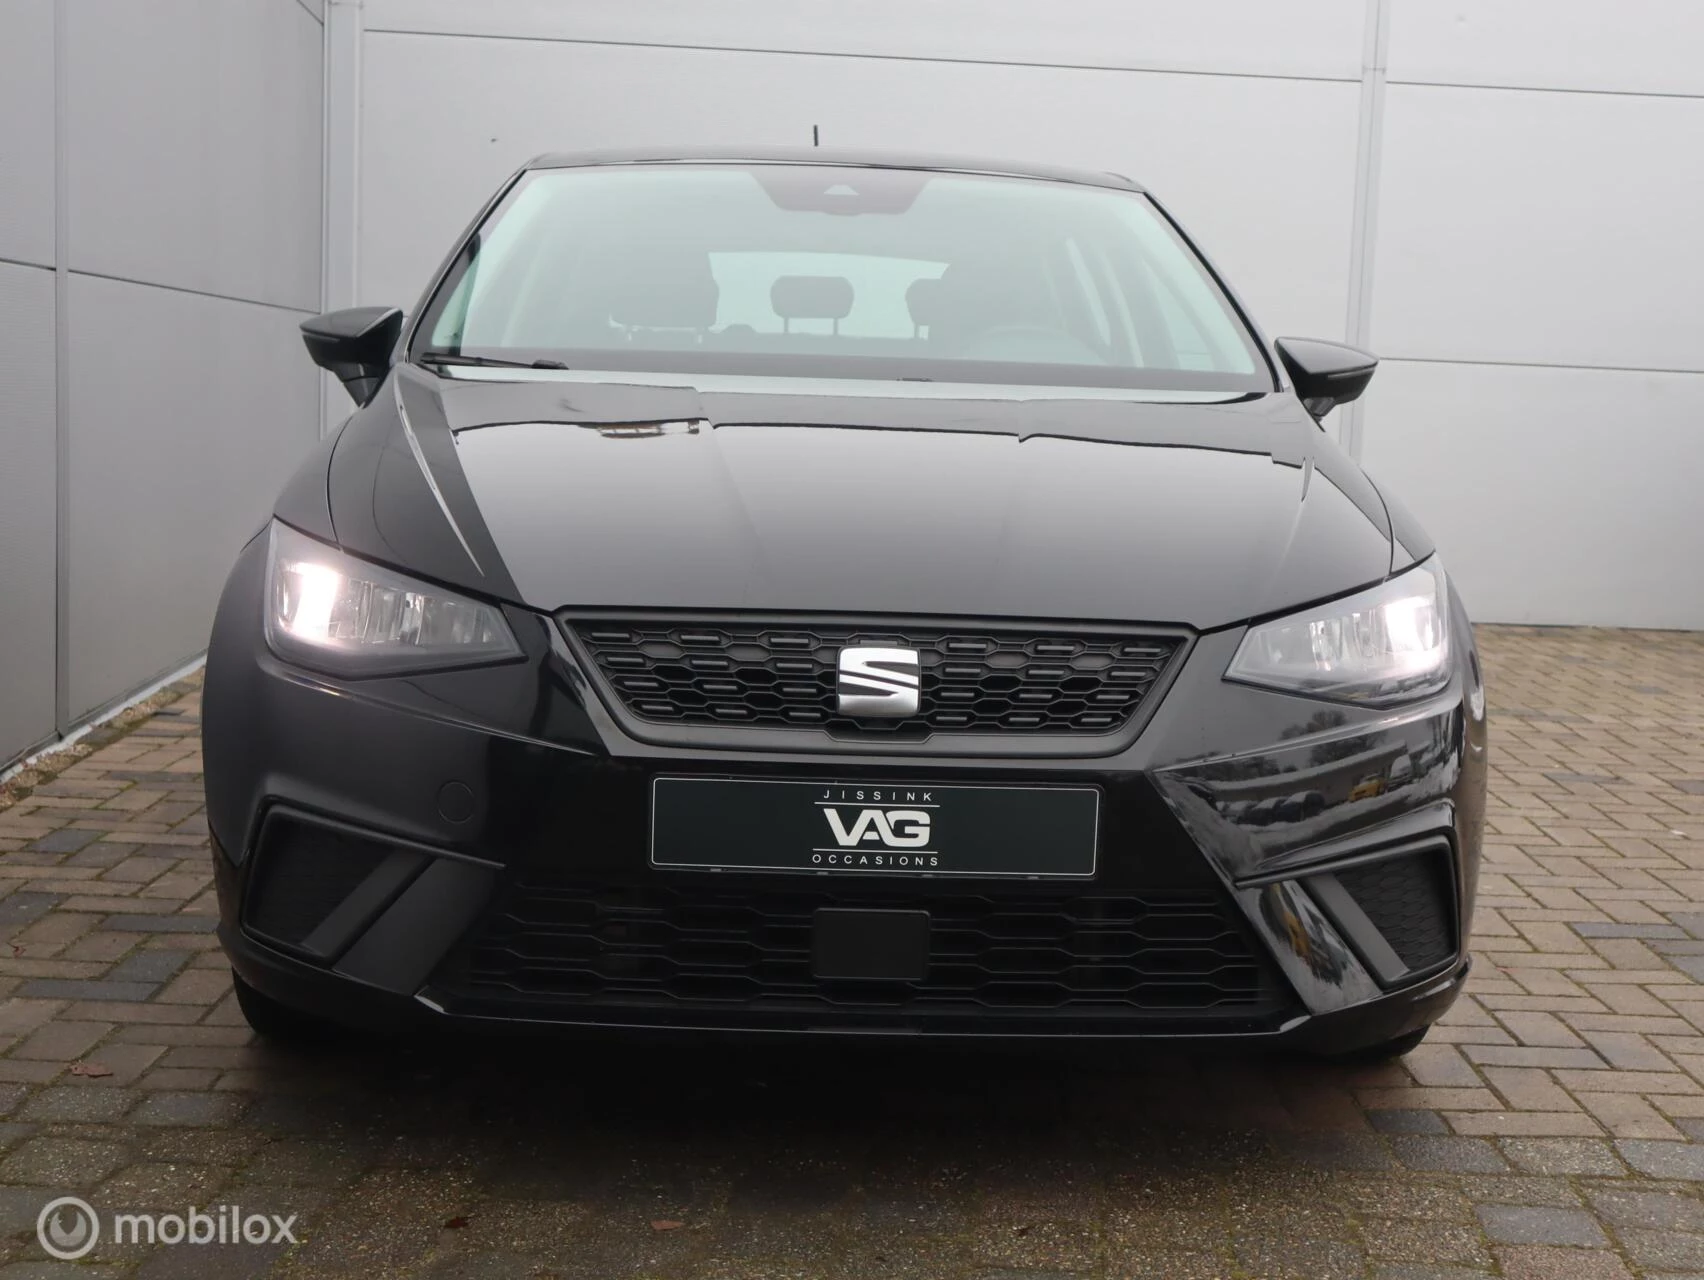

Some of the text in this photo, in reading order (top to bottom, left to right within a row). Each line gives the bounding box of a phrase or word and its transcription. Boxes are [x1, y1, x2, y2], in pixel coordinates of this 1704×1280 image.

[823, 789, 932, 802] JISSINK
[823, 808, 931, 848] VAG
[812, 853, 939, 867] OCCASIONS
